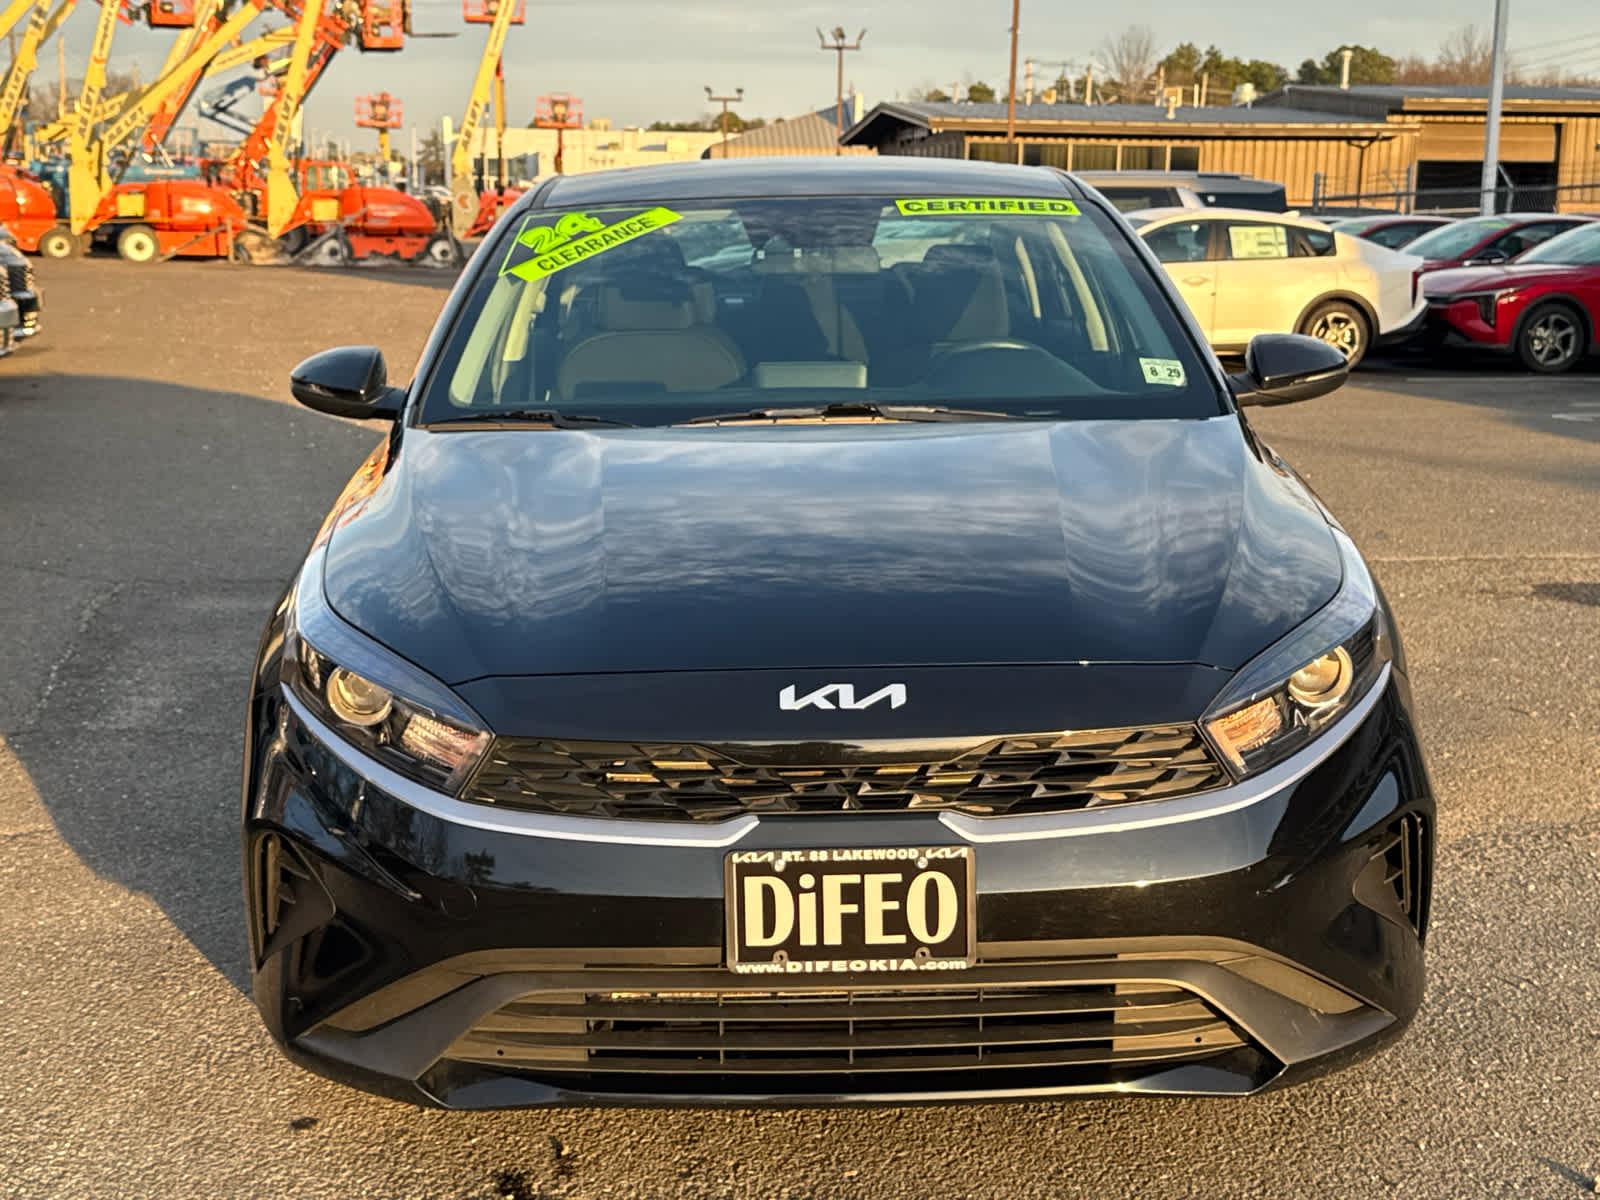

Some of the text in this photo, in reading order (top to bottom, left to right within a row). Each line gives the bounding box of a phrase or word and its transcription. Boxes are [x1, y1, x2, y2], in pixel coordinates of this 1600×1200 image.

[903, 199, 1069, 213] CERTIFIED
[519, 212, 606, 254] 24
[536, 216, 657, 272] CLEARANCE
[1150, 366, 1181, 378] 8 29
[779, 683, 906, 710] KIA
[732, 847, 968, 864] KIA RT. 88 LAKEWOOD KIA
[743, 870, 958, 947] DiFEO
[735, 959, 968, 974] www.DIFEOKIA.com
